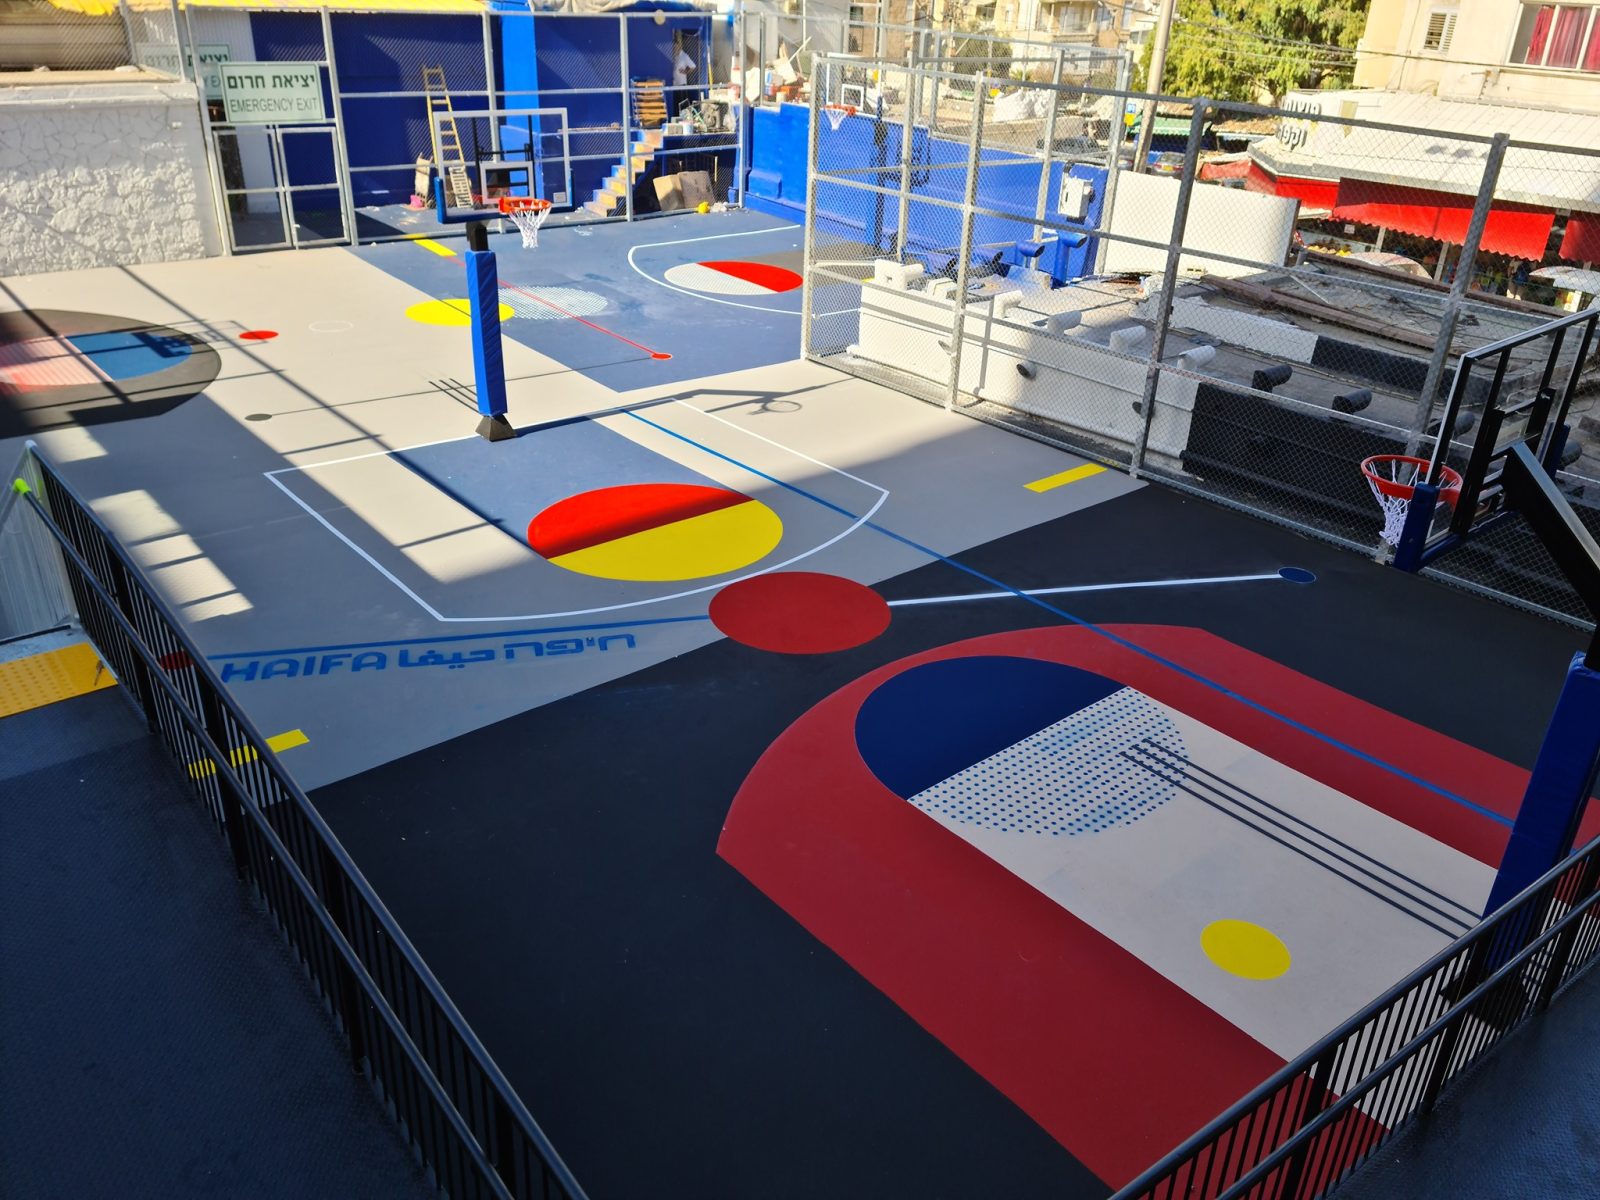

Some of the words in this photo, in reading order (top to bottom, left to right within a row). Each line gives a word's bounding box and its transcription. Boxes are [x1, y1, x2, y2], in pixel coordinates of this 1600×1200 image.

[227, 75, 265, 89] חרום
[271, 75, 315, 88] יציאת
[230, 98, 294, 113] EMERGENCY
[296, 97, 318, 111] EXIT
[220, 650, 388, 684] HAIFA
[398, 648, 495, 670] حيفا
[503, 633, 636, 661] חיפה
